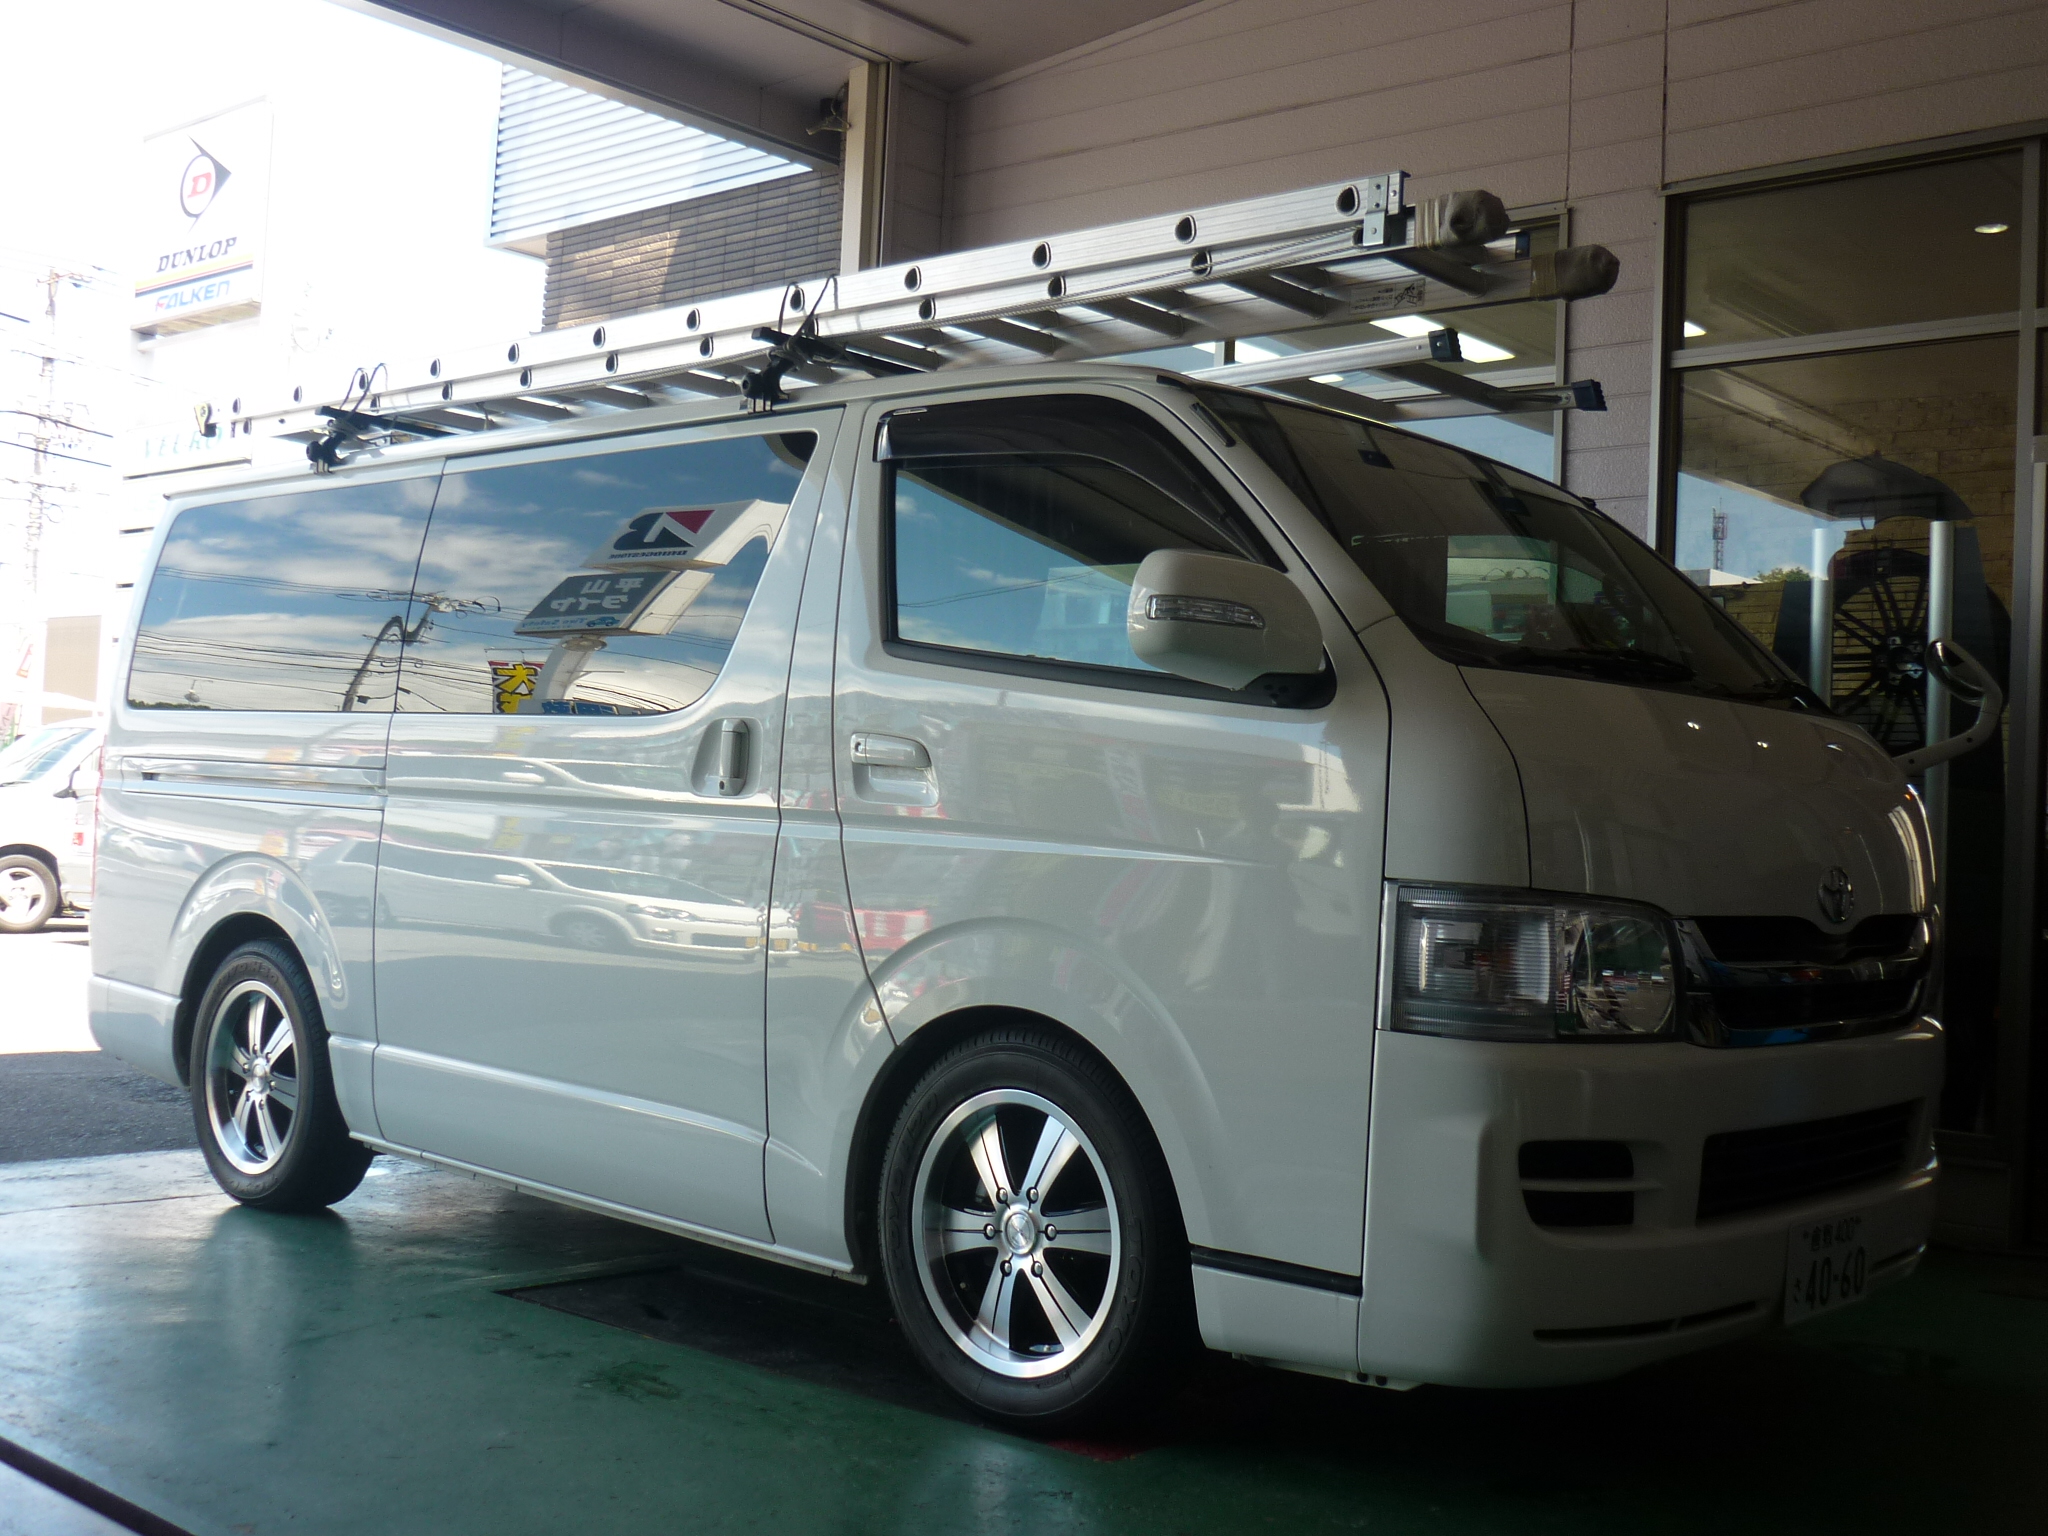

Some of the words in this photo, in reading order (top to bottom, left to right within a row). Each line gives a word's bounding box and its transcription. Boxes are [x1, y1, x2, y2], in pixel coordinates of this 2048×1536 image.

[156, 236, 238, 273] DUNLOP
[154, 280, 231, 312] FALKEN
[1806, 1246, 1865, 1310] 40-60
